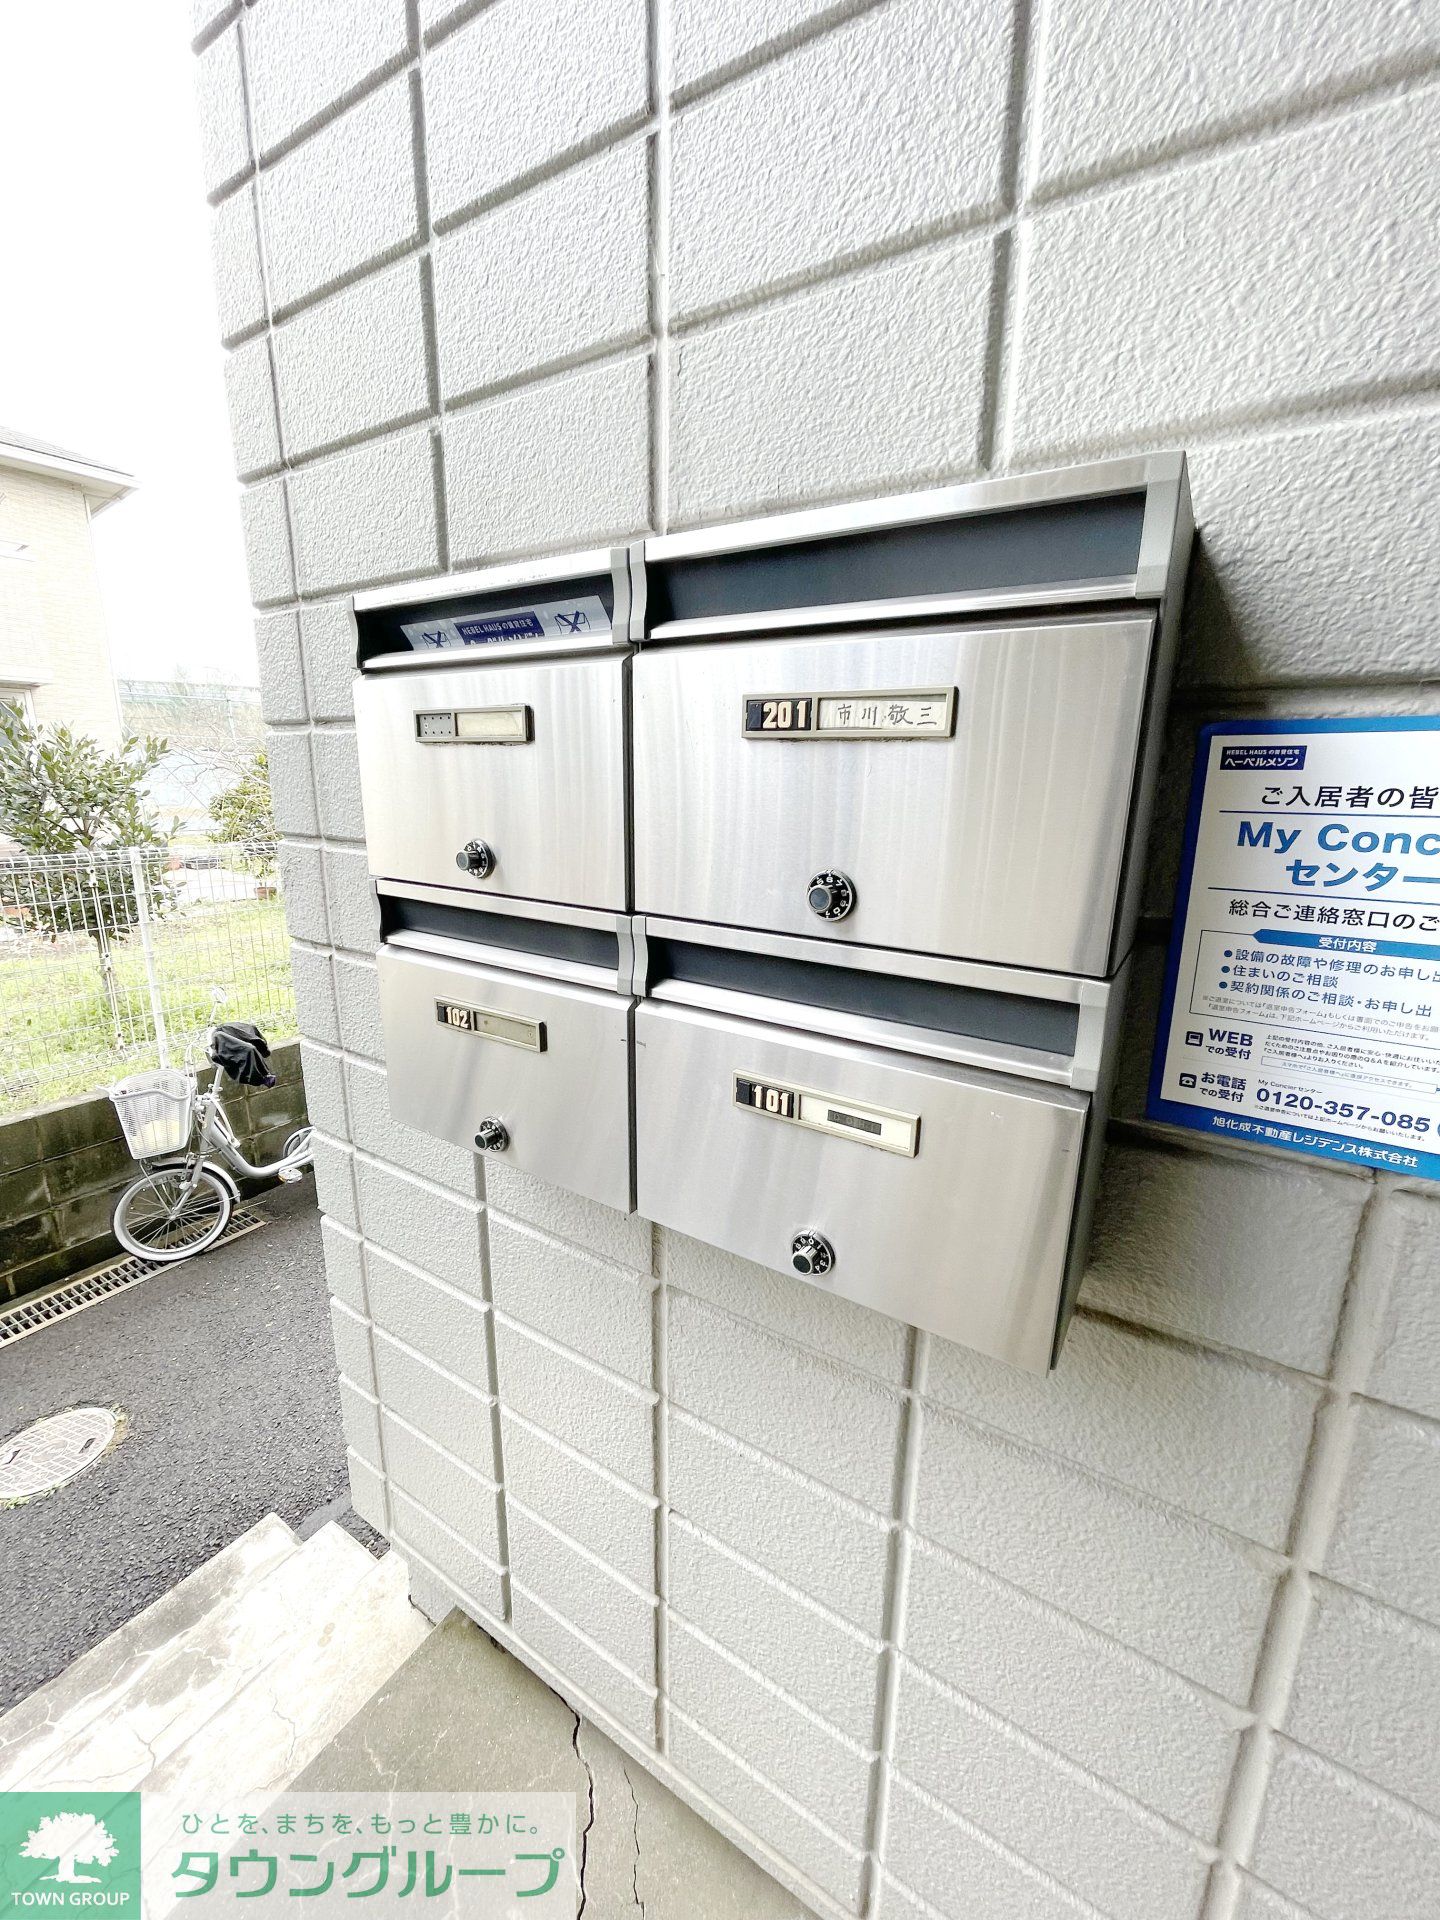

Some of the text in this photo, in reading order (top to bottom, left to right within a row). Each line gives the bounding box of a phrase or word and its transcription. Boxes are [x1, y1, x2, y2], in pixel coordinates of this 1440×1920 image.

[762, 701, 808, 729] 201
[1224, 757, 1299, 767] ヘーベルメゾン
[1261, 785, 1439, 810] ご入居者の皆
[1237, 821, 1301, 854] My
[1285, 859, 1440, 892] センター
[1228, 898, 1440, 931] 総合ご連絡窓口のご
[1318, 936, 1377, 953] 受付内容
[1233, 964, 1339, 988] 住まいのご相談
[446, 1006, 469, 1029] 102
[1208, 1028, 1253, 1046] WEB
[1206, 1045, 1251, 1060] での受付
[1201, 1072, 1247, 1091] お電話
[752, 1085, 790, 1116] 101
[1199, 1087, 1244, 1103] での受付
[1256, 1087, 1431, 1133] 0120-357-085
[1212, 1115, 1419, 1169] 旭化成不動産レジデンス株式会社
